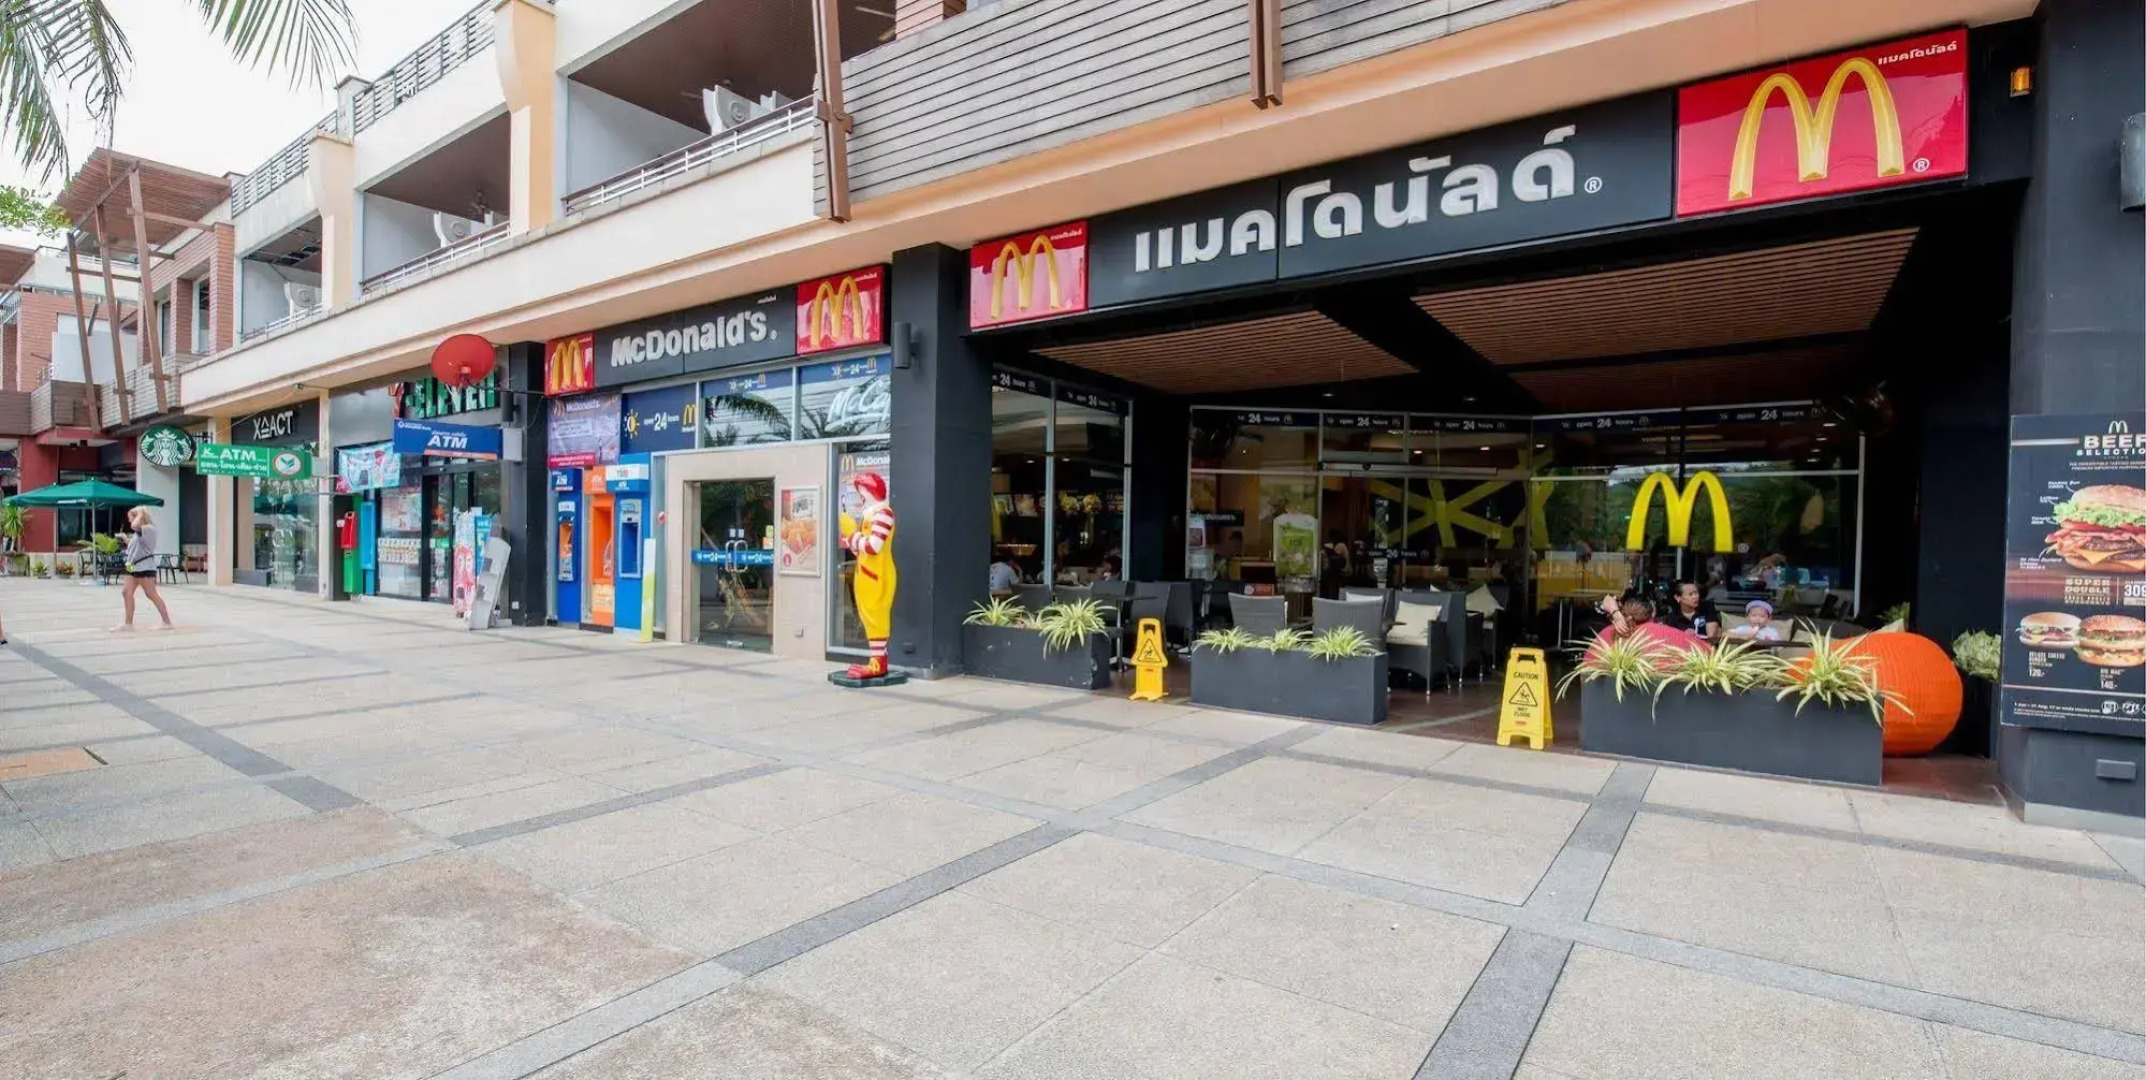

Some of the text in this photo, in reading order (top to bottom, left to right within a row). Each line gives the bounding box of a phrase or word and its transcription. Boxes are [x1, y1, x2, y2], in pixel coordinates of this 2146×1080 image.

[1878, 41, 1957, 64] แมคโดนัลด์
[1135, 124, 1577, 272] แมคโดนัลด์
[611, 311, 767, 367] McDonald's
[1249, 413, 1261, 424] 24
[1761, 409, 1778, 420] 24
[654, 411, 667, 431] 24
[1358, 416, 1370, 427] 24
[1463, 420, 1475, 430] 24
[1597, 418, 1612, 428] 24
[427, 435, 468, 449] ATM
[220, 449, 257, 461] ATM
[2065, 578, 2110, 586] SUPER
[1514, 672, 1538, 680] CAUTION
